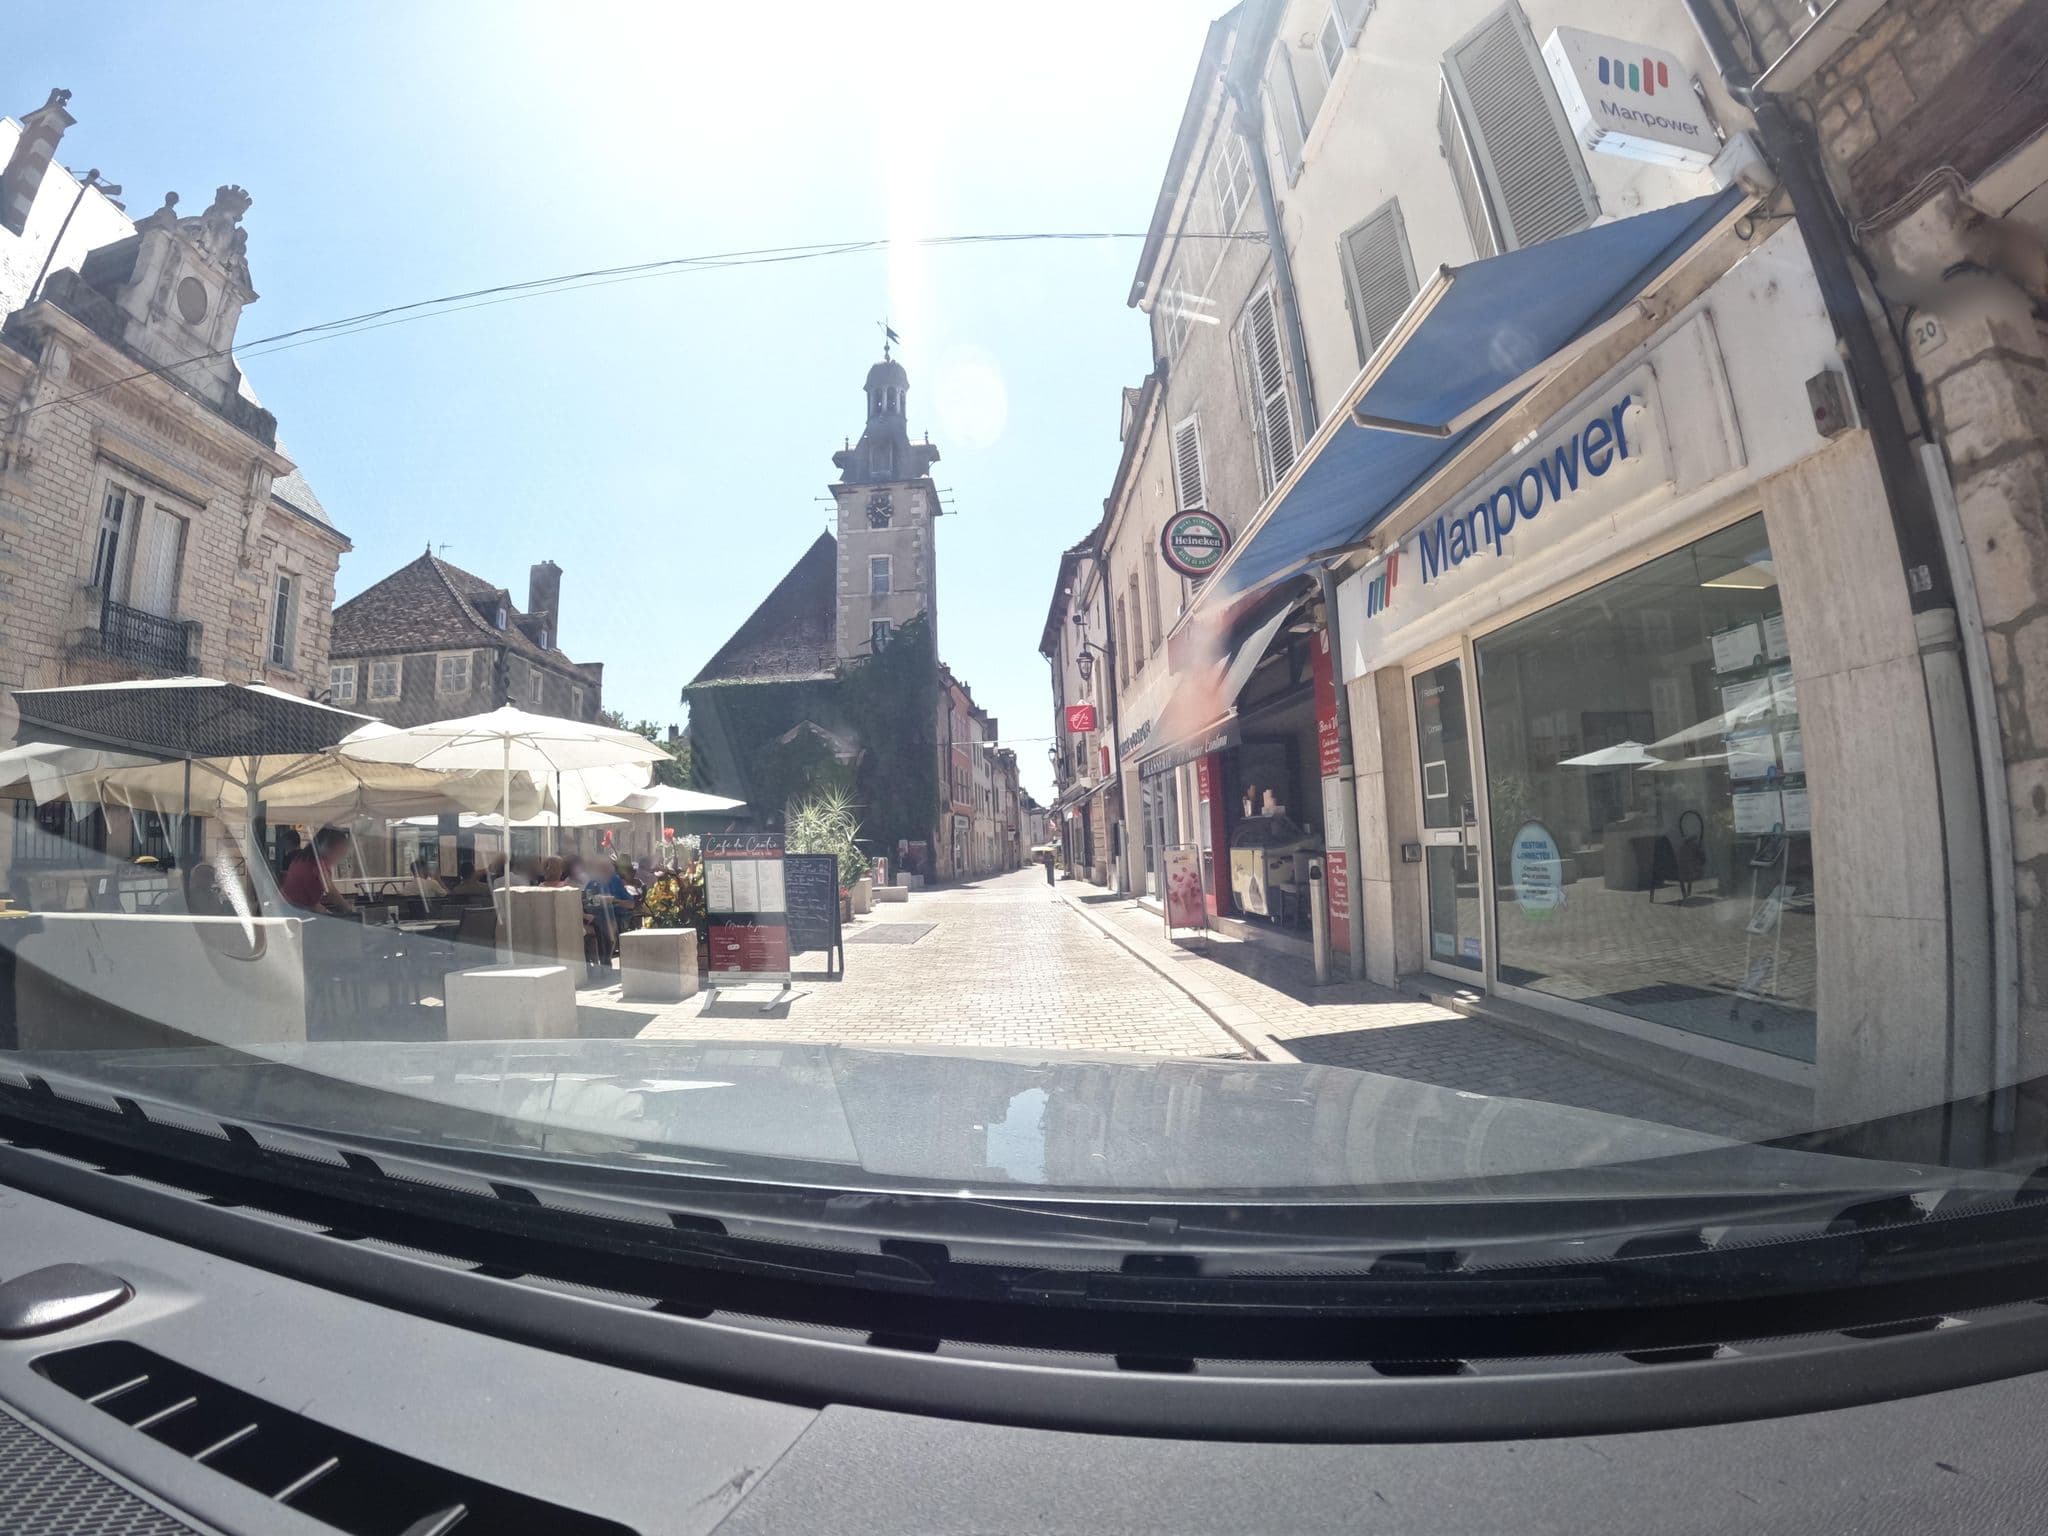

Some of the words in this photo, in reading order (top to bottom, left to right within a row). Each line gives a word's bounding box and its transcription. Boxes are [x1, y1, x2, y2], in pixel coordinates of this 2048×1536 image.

[1600, 100, 1699, 136] Manpower
[1915, 321, 1937, 345] 20
[1418, 394, 1635, 585] Manpower
[1175, 536, 1221, 547] Heineken
[746, 836, 777, 853] Centre
